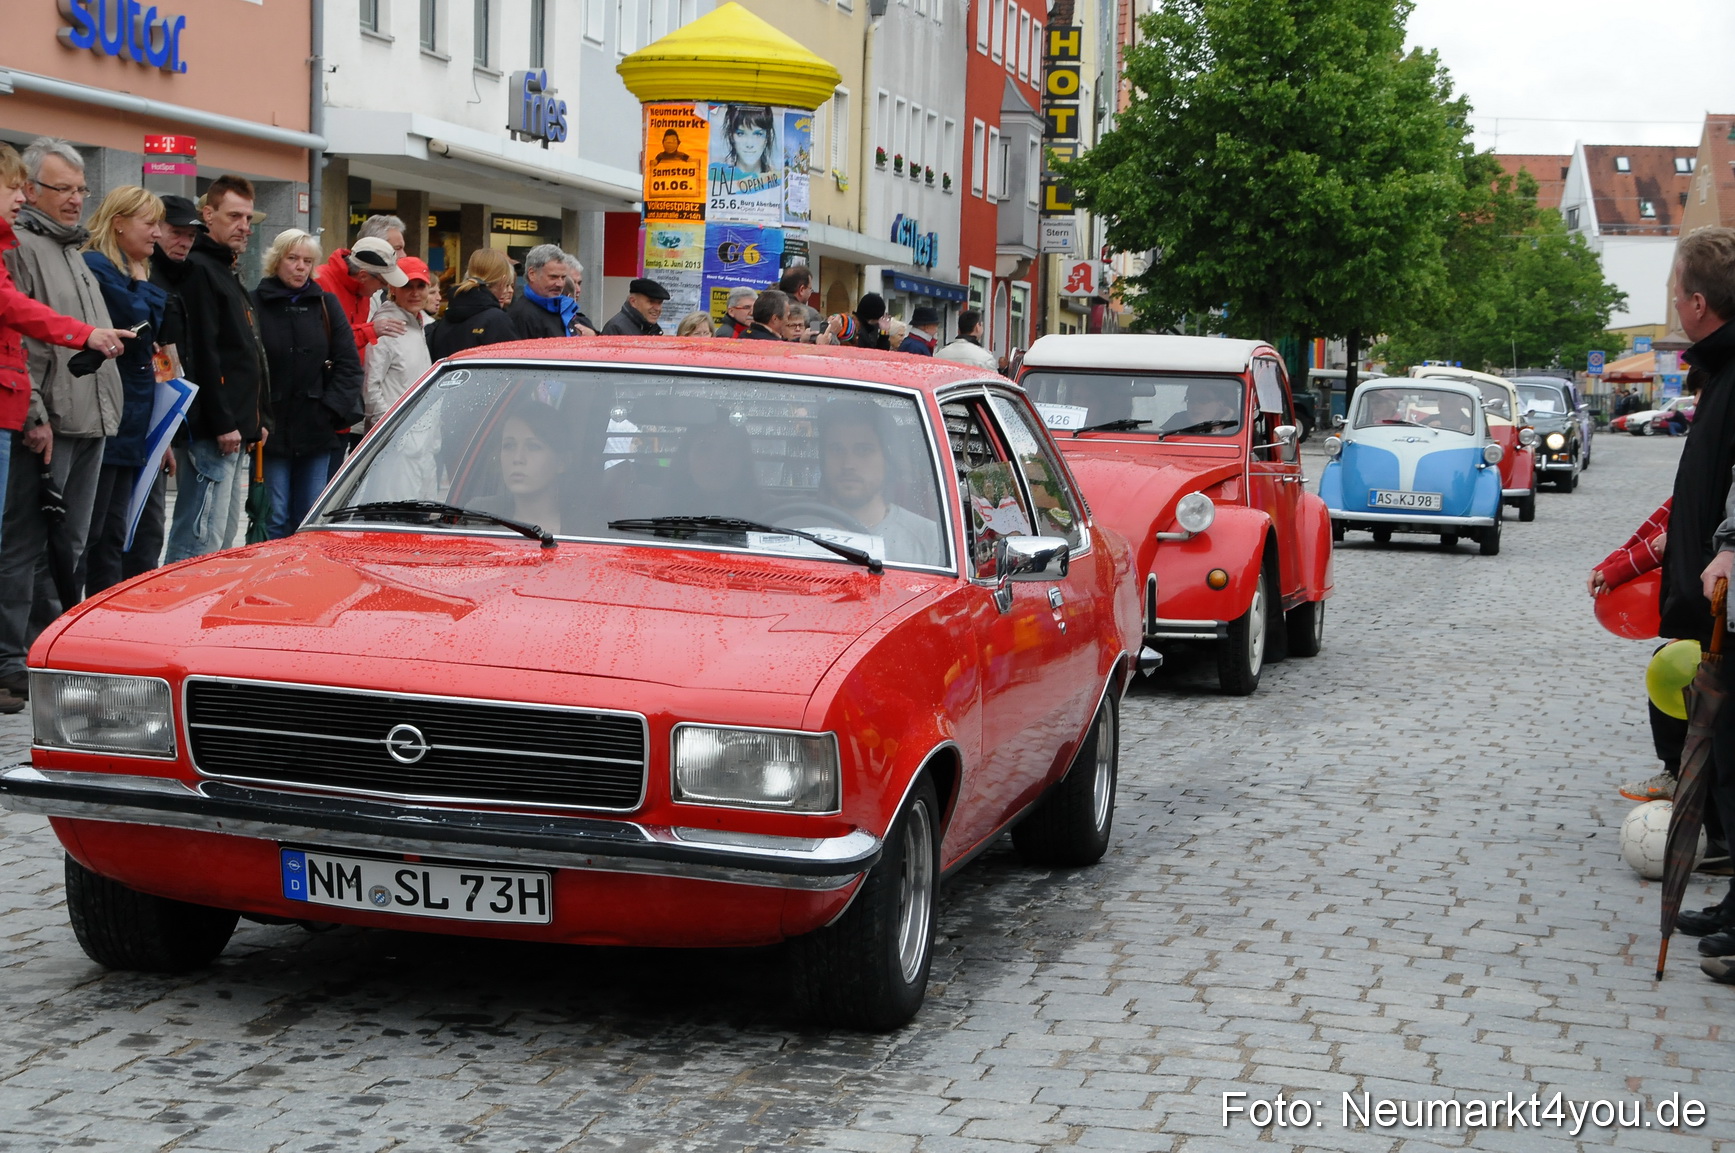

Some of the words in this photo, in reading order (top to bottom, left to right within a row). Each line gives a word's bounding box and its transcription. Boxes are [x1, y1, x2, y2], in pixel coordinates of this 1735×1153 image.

[522, 69, 567, 142] fries
[650, 108, 695, 117] Neumarkt
[650, 118, 706, 129] Flohmarkt
[1046, 30, 1080, 211] HOTEL
[162, 136, 175, 153] T
[151, 163, 176, 172] HotSpot
[652, 167, 696, 177] Samstag
[653, 180, 693, 191] 01.06.
[710, 166, 736, 197] ZAZ
[739, 177, 764, 194] OPEN
[767, 173, 780, 189] AIR
[648, 201, 700, 212] Volksfestplatz
[710, 198, 740, 210] 25.6.
[740, 200, 755, 208] Burg
[493, 217, 538, 232] FRIES
[1046, 228, 1069, 237] Stern
[664, 259, 670, 267] 2.
[670, 260, 684, 268] Juni
[685, 260, 702, 269] 2013
[1047, 414, 1071, 426] 426
[1377, 493, 1392, 505] AS
[1399, 494, 1416, 506] KJ
[1417, 495, 1432, 507] 98
[291, 879, 300, 891] D
[307, 858, 363, 902] NM
[394, 868, 449, 910] SL
[460, 873, 547, 916] 73H
